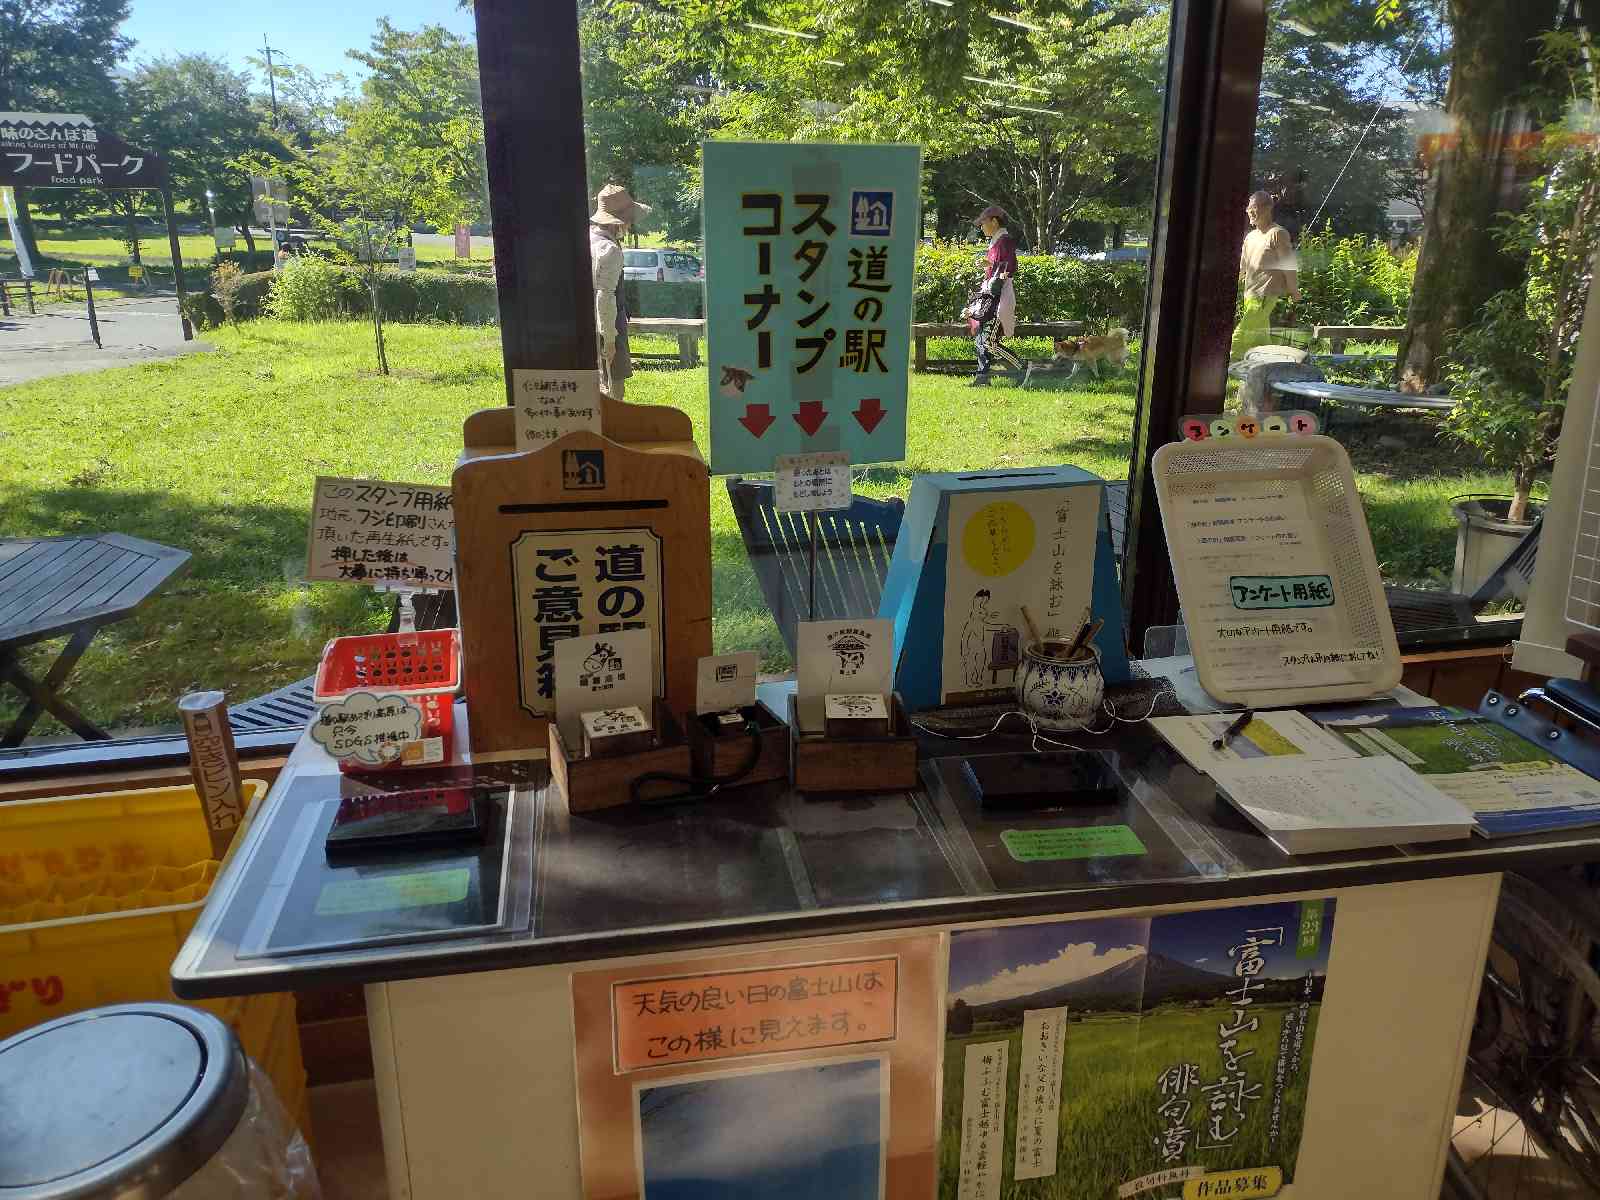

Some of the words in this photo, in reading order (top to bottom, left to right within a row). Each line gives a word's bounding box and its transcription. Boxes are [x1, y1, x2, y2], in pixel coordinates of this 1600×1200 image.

[6, 153, 144, 175] フードパーク
[79, 175, 104, 185] park
[741, 193, 783, 369] コーナー
[791, 194, 838, 374] スタンプ
[840, 245, 893, 373] 道の駅
[594, 544, 646, 634] 道の
[1232, 581, 1332, 602] アンケート用紙
[632, 971, 884, 1017] 天気の良い日の富士山は
[647, 1009, 867, 1059] この様に見えます。
[1196, 927, 1284, 1149] 「富士山を詠む」
[1154, 1063, 1199, 1162] 俳句賞
[1197, 1174, 1269, 1198] 作品募集
